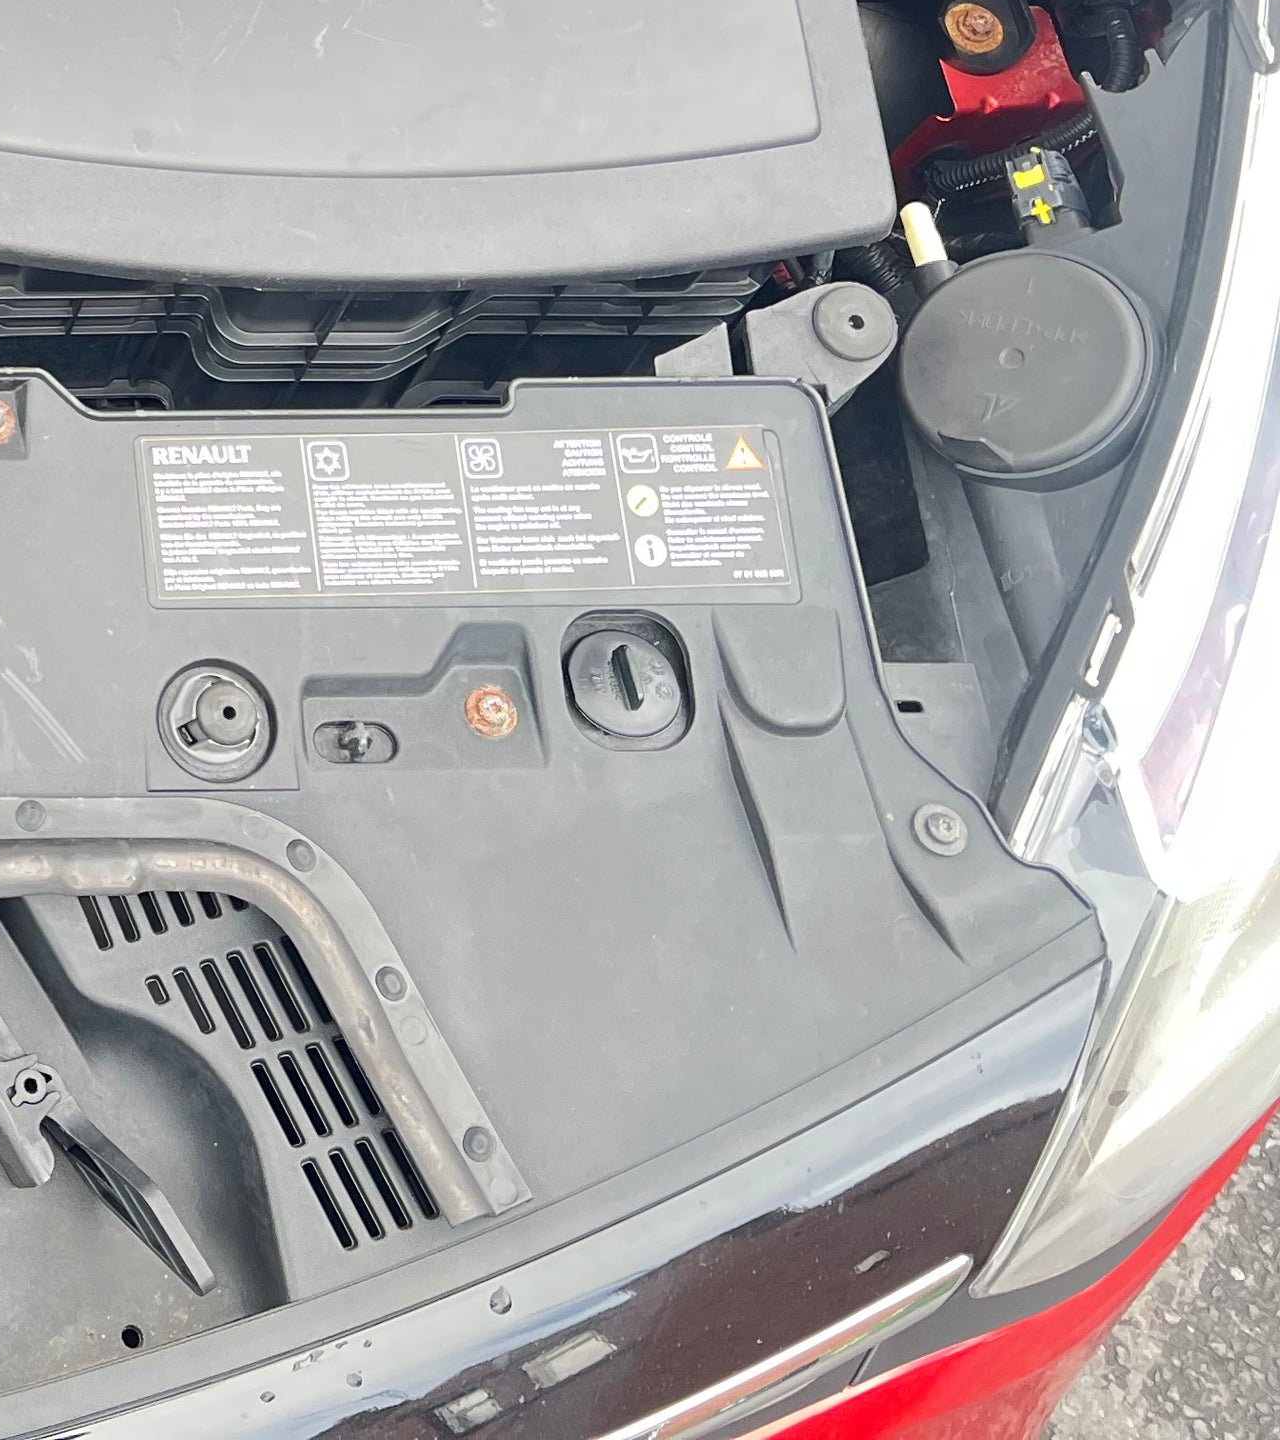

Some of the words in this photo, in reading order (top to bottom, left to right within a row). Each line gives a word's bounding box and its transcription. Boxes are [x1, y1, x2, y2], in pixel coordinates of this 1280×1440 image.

[663, 433, 713, 443] CONTROLE
[553, 440, 602, 448] ATTENTION
[670, 444, 714, 453] CONTROL
[152, 445, 252, 465] RENAULT
[565, 449, 603, 458] CAUTION
[661, 453, 716, 463] KONTROLLE
[673, 464, 718, 473] CONTROL
